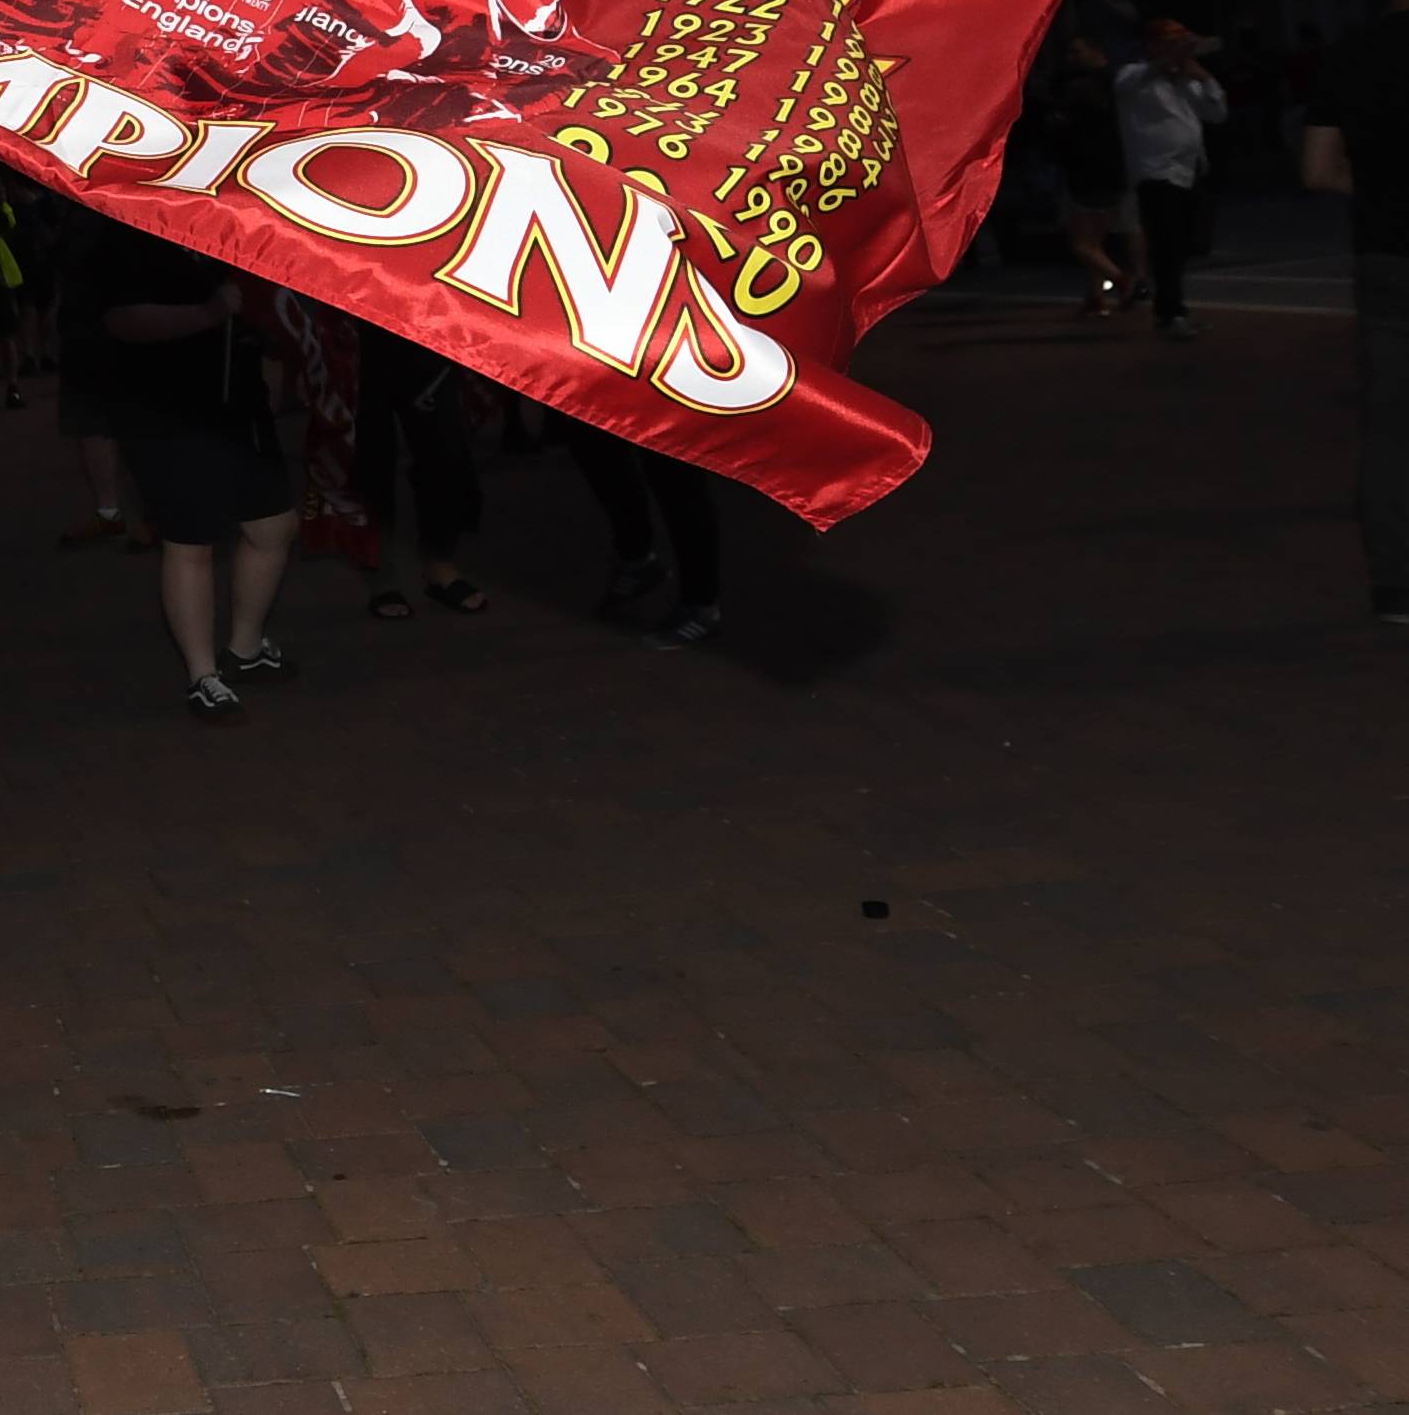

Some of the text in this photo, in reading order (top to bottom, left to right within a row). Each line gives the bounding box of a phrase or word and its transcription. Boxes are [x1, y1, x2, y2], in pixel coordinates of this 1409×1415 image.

[641, 10, 773, 45] 1923
[624, 42, 759, 73] 1947
[607, 64, 736, 107] 1964
[563, 88, 693, 159] 1976
[714, 167, 823, 272] 1990
